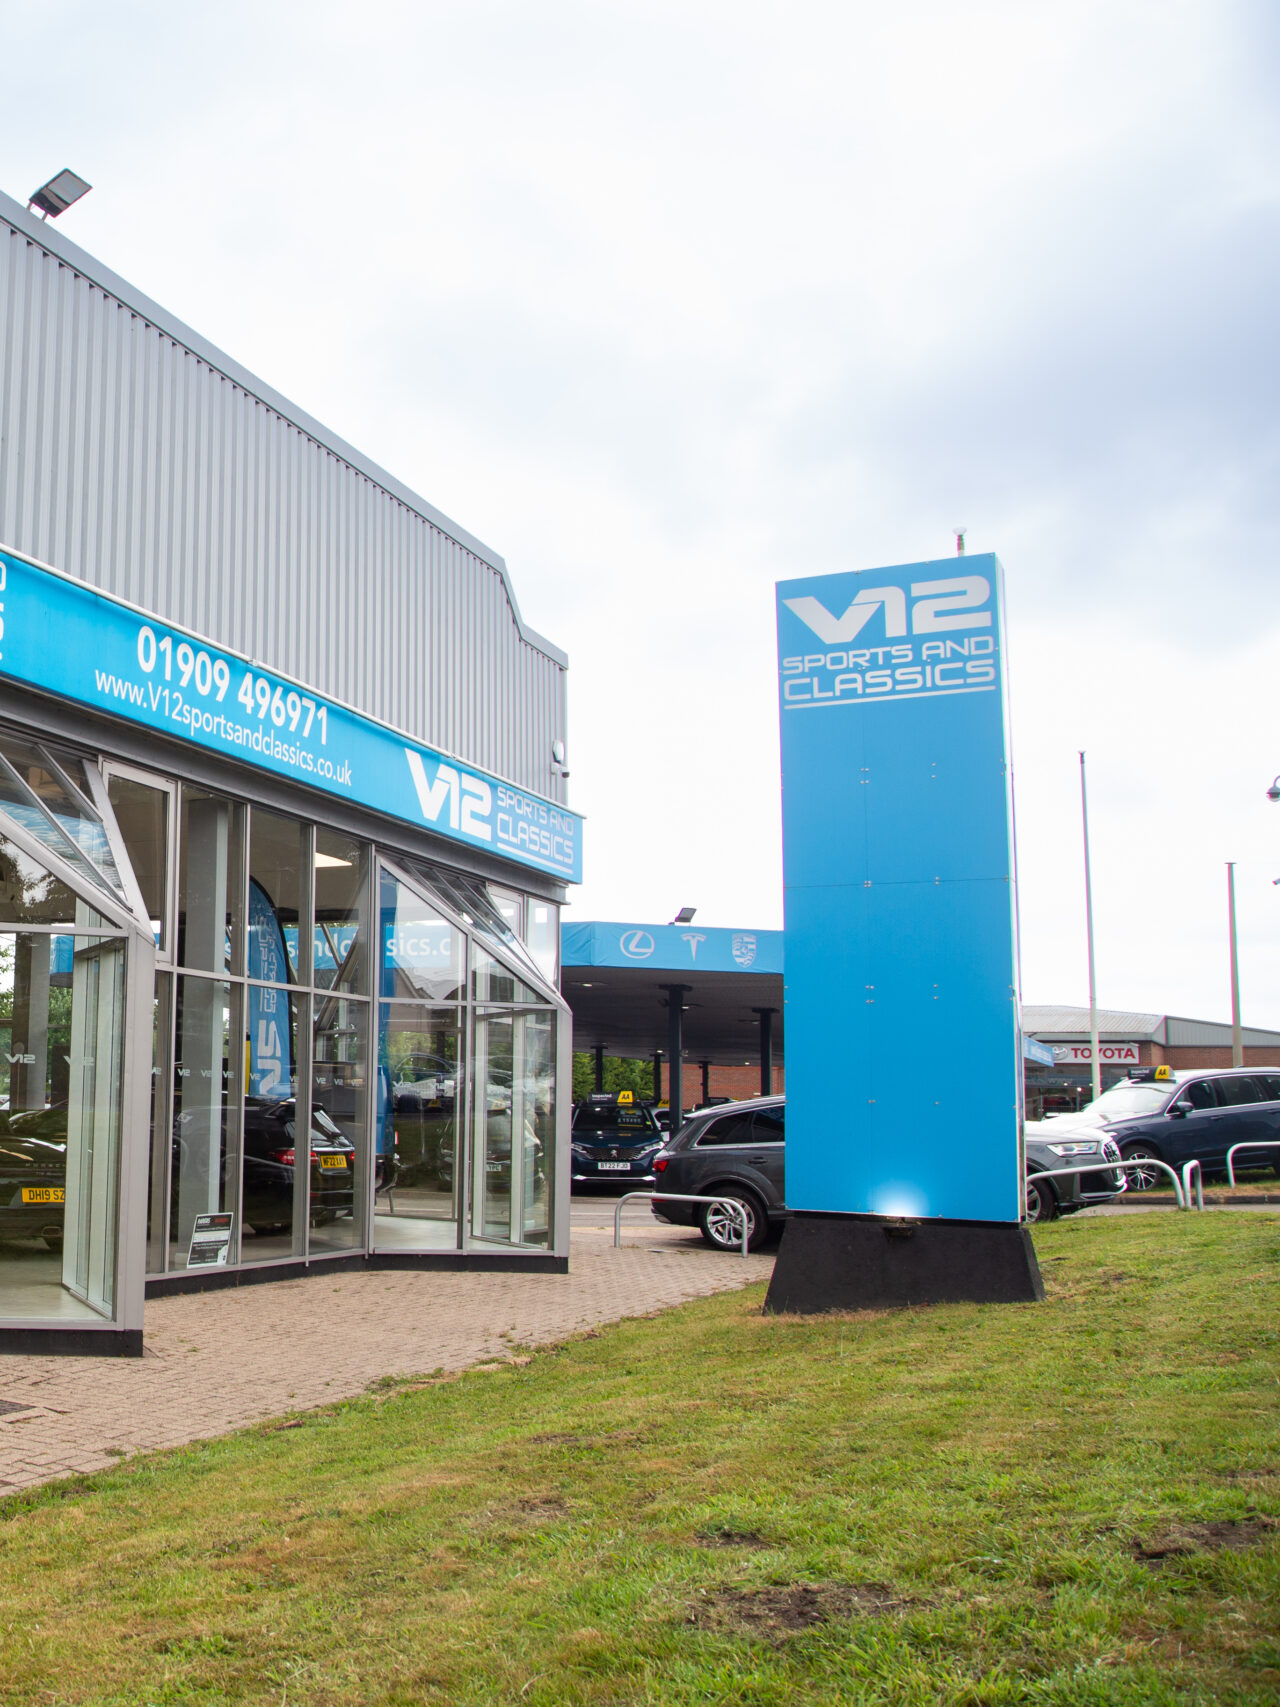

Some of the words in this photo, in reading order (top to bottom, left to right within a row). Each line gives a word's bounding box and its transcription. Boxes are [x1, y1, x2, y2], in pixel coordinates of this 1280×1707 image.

[781, 575, 992, 645] V12
[782, 644, 913, 675] SPORTS
[922, 635, 994, 661] AND
[784, 659, 996, 701] CLASSICS
[137, 625, 230, 702] 01909
[238, 672, 328, 746] 496971
[95, 669, 352, 786] www.V12sportsandclassics.co.uk
[404, 747, 492, 842] V12
[497, 785, 548, 825] SPORTS
[549, 810, 574, 836] AND
[497, 812, 574, 865] CLASSICS
[5, 1053, 36, 1064] V12
[28, 1189, 51, 1200] DH19
[53, 1189, 65, 1200] SZ
